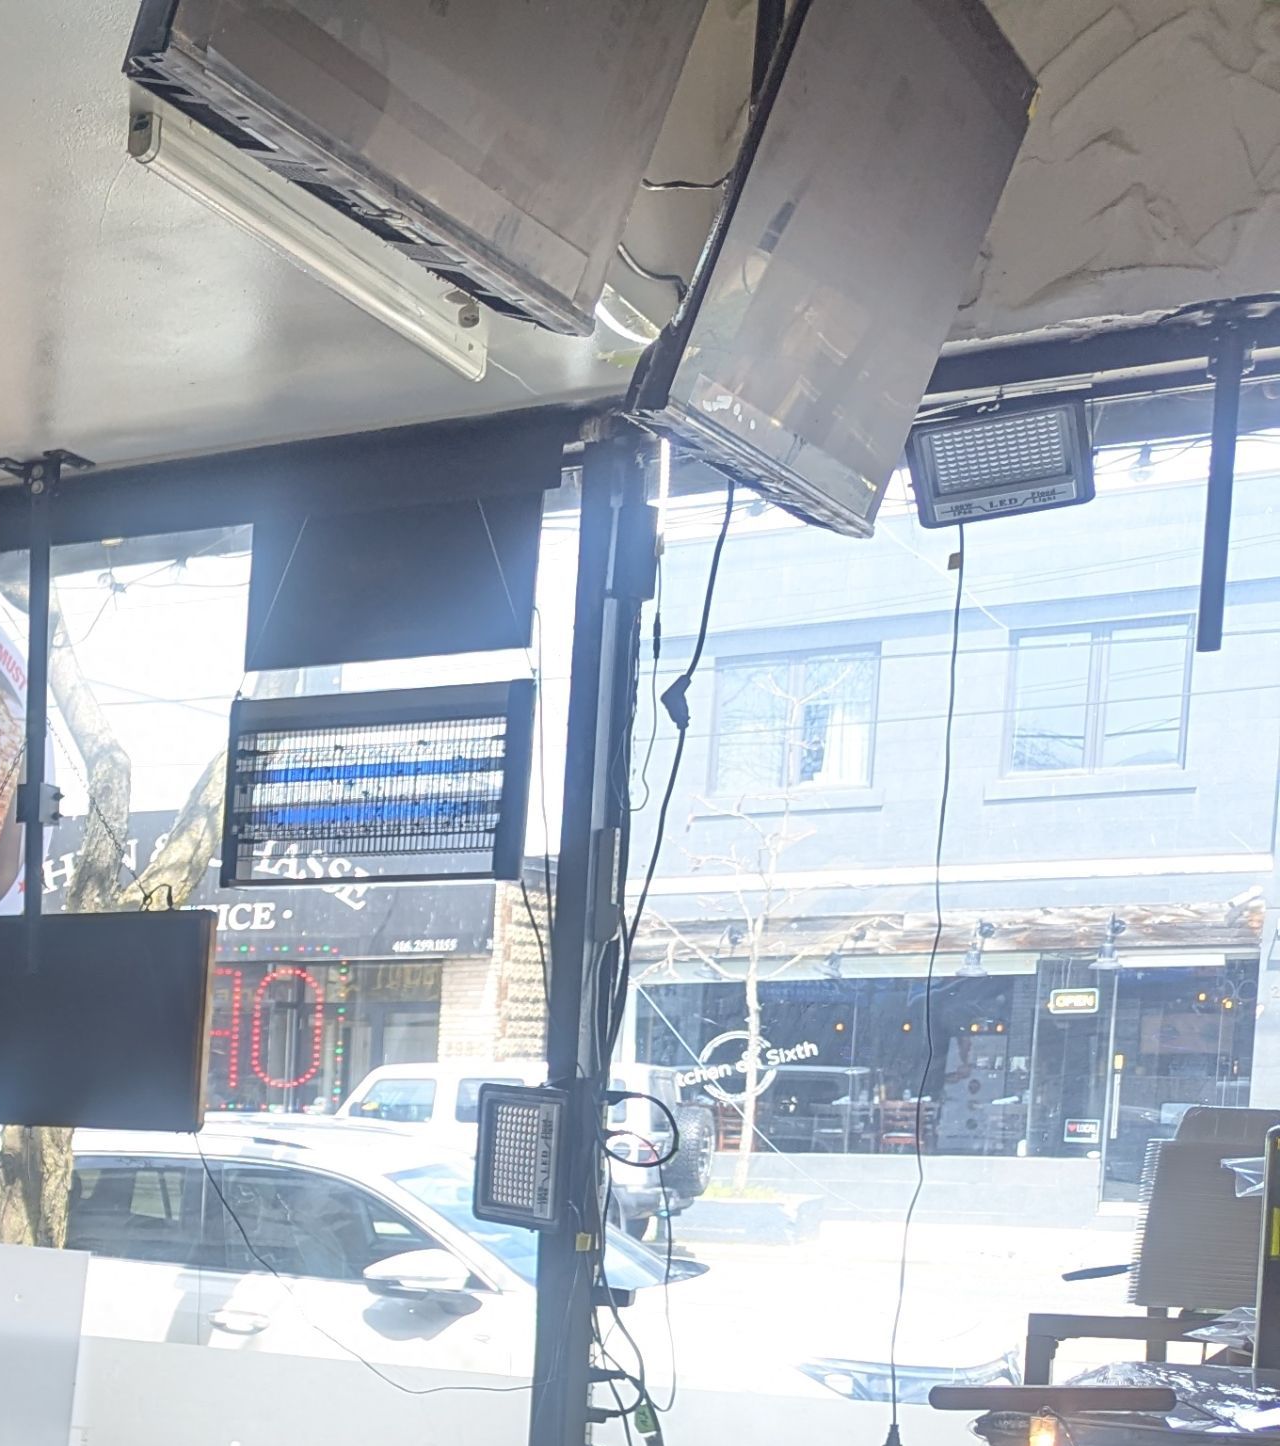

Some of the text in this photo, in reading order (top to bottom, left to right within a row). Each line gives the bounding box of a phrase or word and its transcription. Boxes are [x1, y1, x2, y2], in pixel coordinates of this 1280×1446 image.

[989, 498, 1018, 509] LED
[675, 1062, 733, 1089] tchen
[765, 1040, 820, 1066] Sixth
